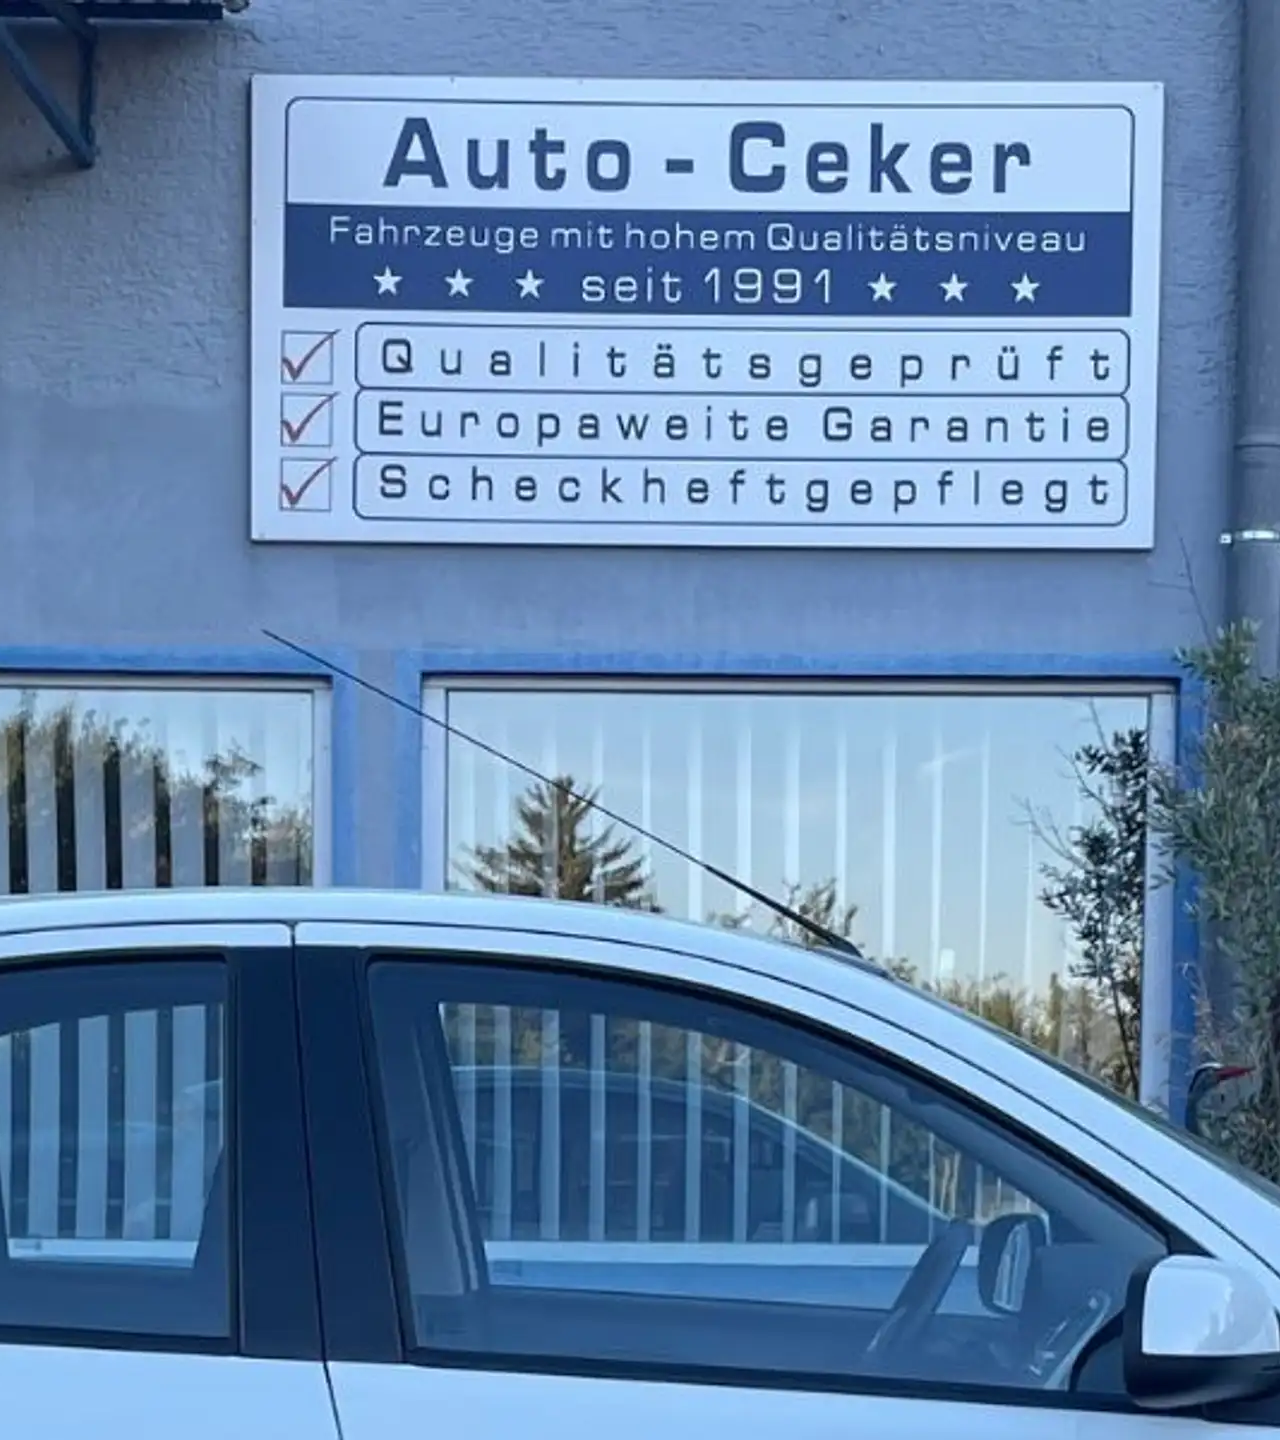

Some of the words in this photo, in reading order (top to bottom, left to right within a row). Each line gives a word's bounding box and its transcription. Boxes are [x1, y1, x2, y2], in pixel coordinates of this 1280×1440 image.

[329, 215, 539, 252] Fahrzeuge
[551, 222, 615, 249] mit
[625, 222, 755, 251] hohem
[766, 220, 1086, 253] Qualitätsniveau
[581, 269, 682, 302] seit
[704, 268, 832, 304] 1991
[380, 338, 1111, 386] Qualitätsgeprüft
[378, 400, 789, 446] Europaweite
[822, 406, 1111, 443] Garantie
[379, 463, 1109, 514] Scheckheftgepflegt
